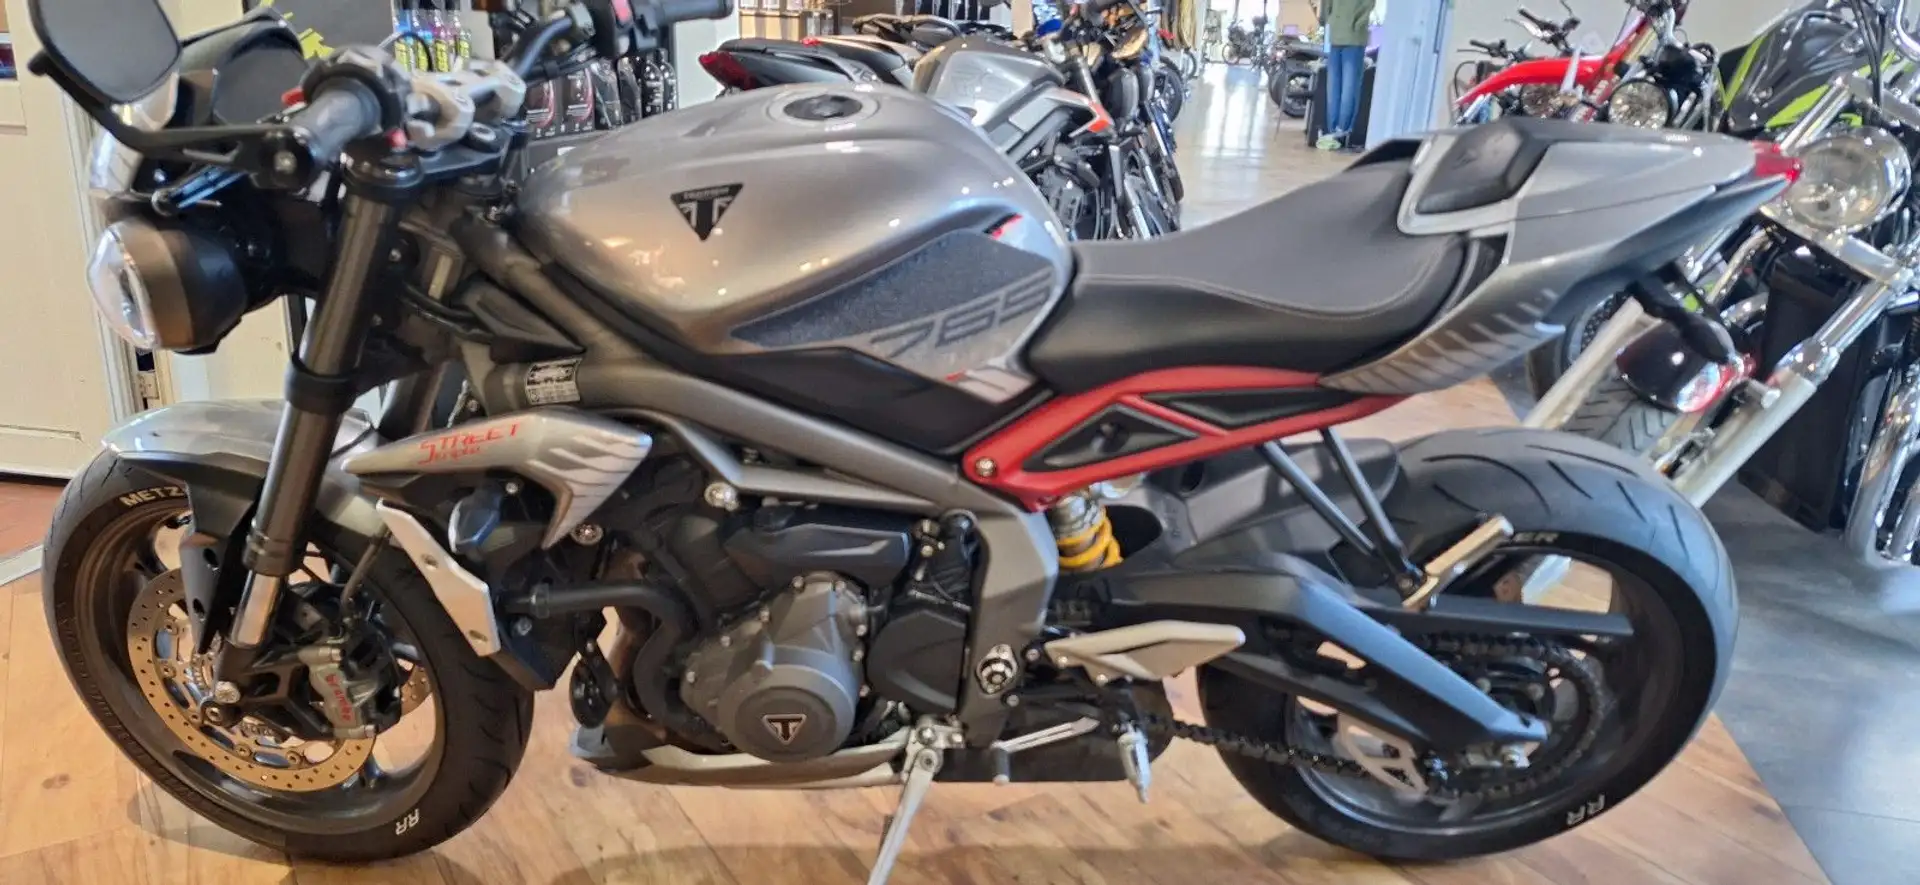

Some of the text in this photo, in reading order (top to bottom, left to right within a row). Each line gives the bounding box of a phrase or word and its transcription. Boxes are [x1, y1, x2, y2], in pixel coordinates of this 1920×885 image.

[870, 268, 1053, 358] 765
[395, 808, 420, 836] RR
[1566, 793, 1606, 826] RR
